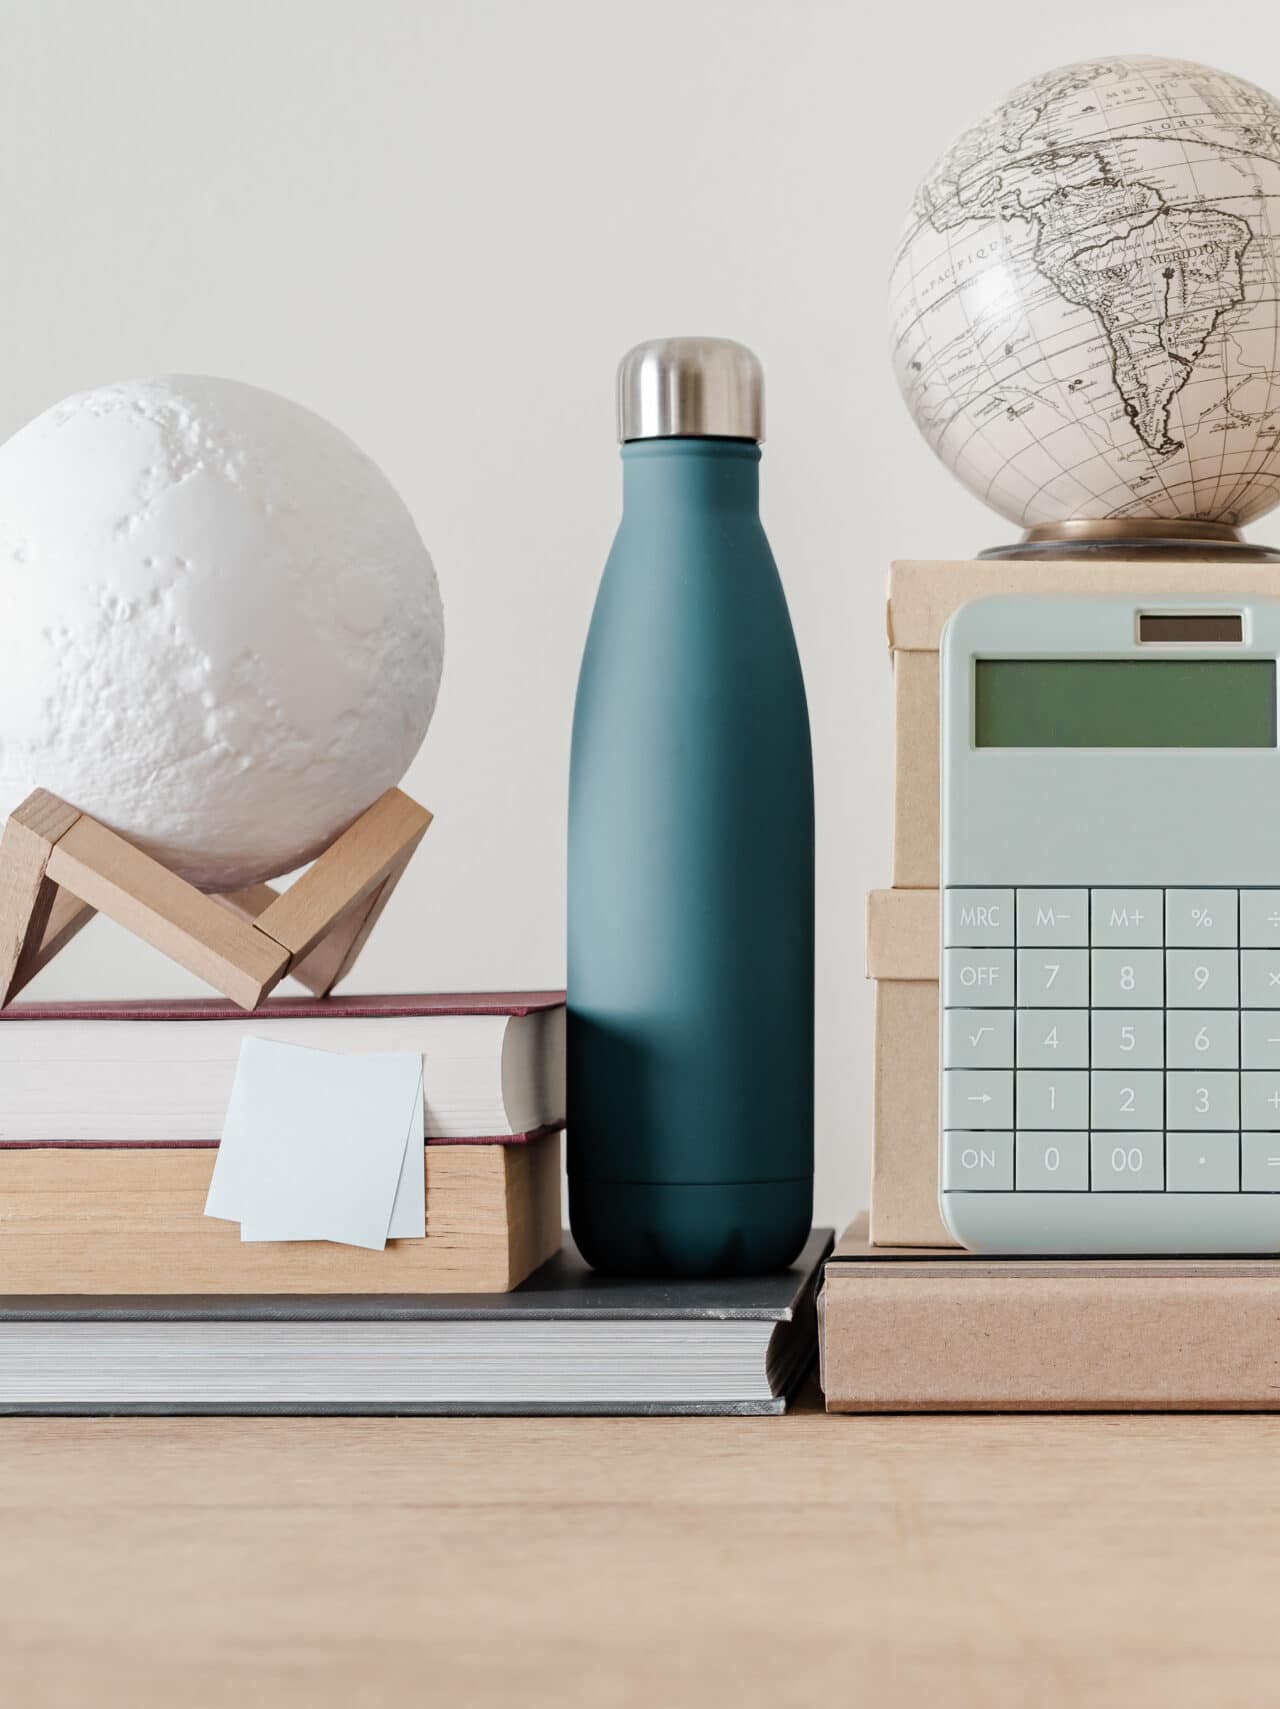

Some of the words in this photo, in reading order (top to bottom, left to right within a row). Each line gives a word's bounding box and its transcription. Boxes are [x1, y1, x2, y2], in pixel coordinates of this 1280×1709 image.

[1143, 118, 1205, 134] NORD
[960, 906, 999, 928] MRC
[1110, 908, 1144, 927] M+
[1192, 909, 1212, 928] %
[960, 967, 999, 986] OFF
[1044, 965, 1060, 989] 7
[1120, 966, 1135, 990] 8
[1194, 966, 1209, 990] 9
[1044, 1026, 1060, 1049] 4
[1120, 1027, 1136, 1050] 5
[1194, 1027, 1210, 1051] 6
[1048, 1086, 1056, 1111] 1
[1120, 1088, 1136, 1112] 2
[1195, 1088, 1210, 1113] 3
[961, 1149, 996, 1169] ON
[1044, 1147, 1060, 1171] 0
[1111, 1148, 1143, 1171] 00
